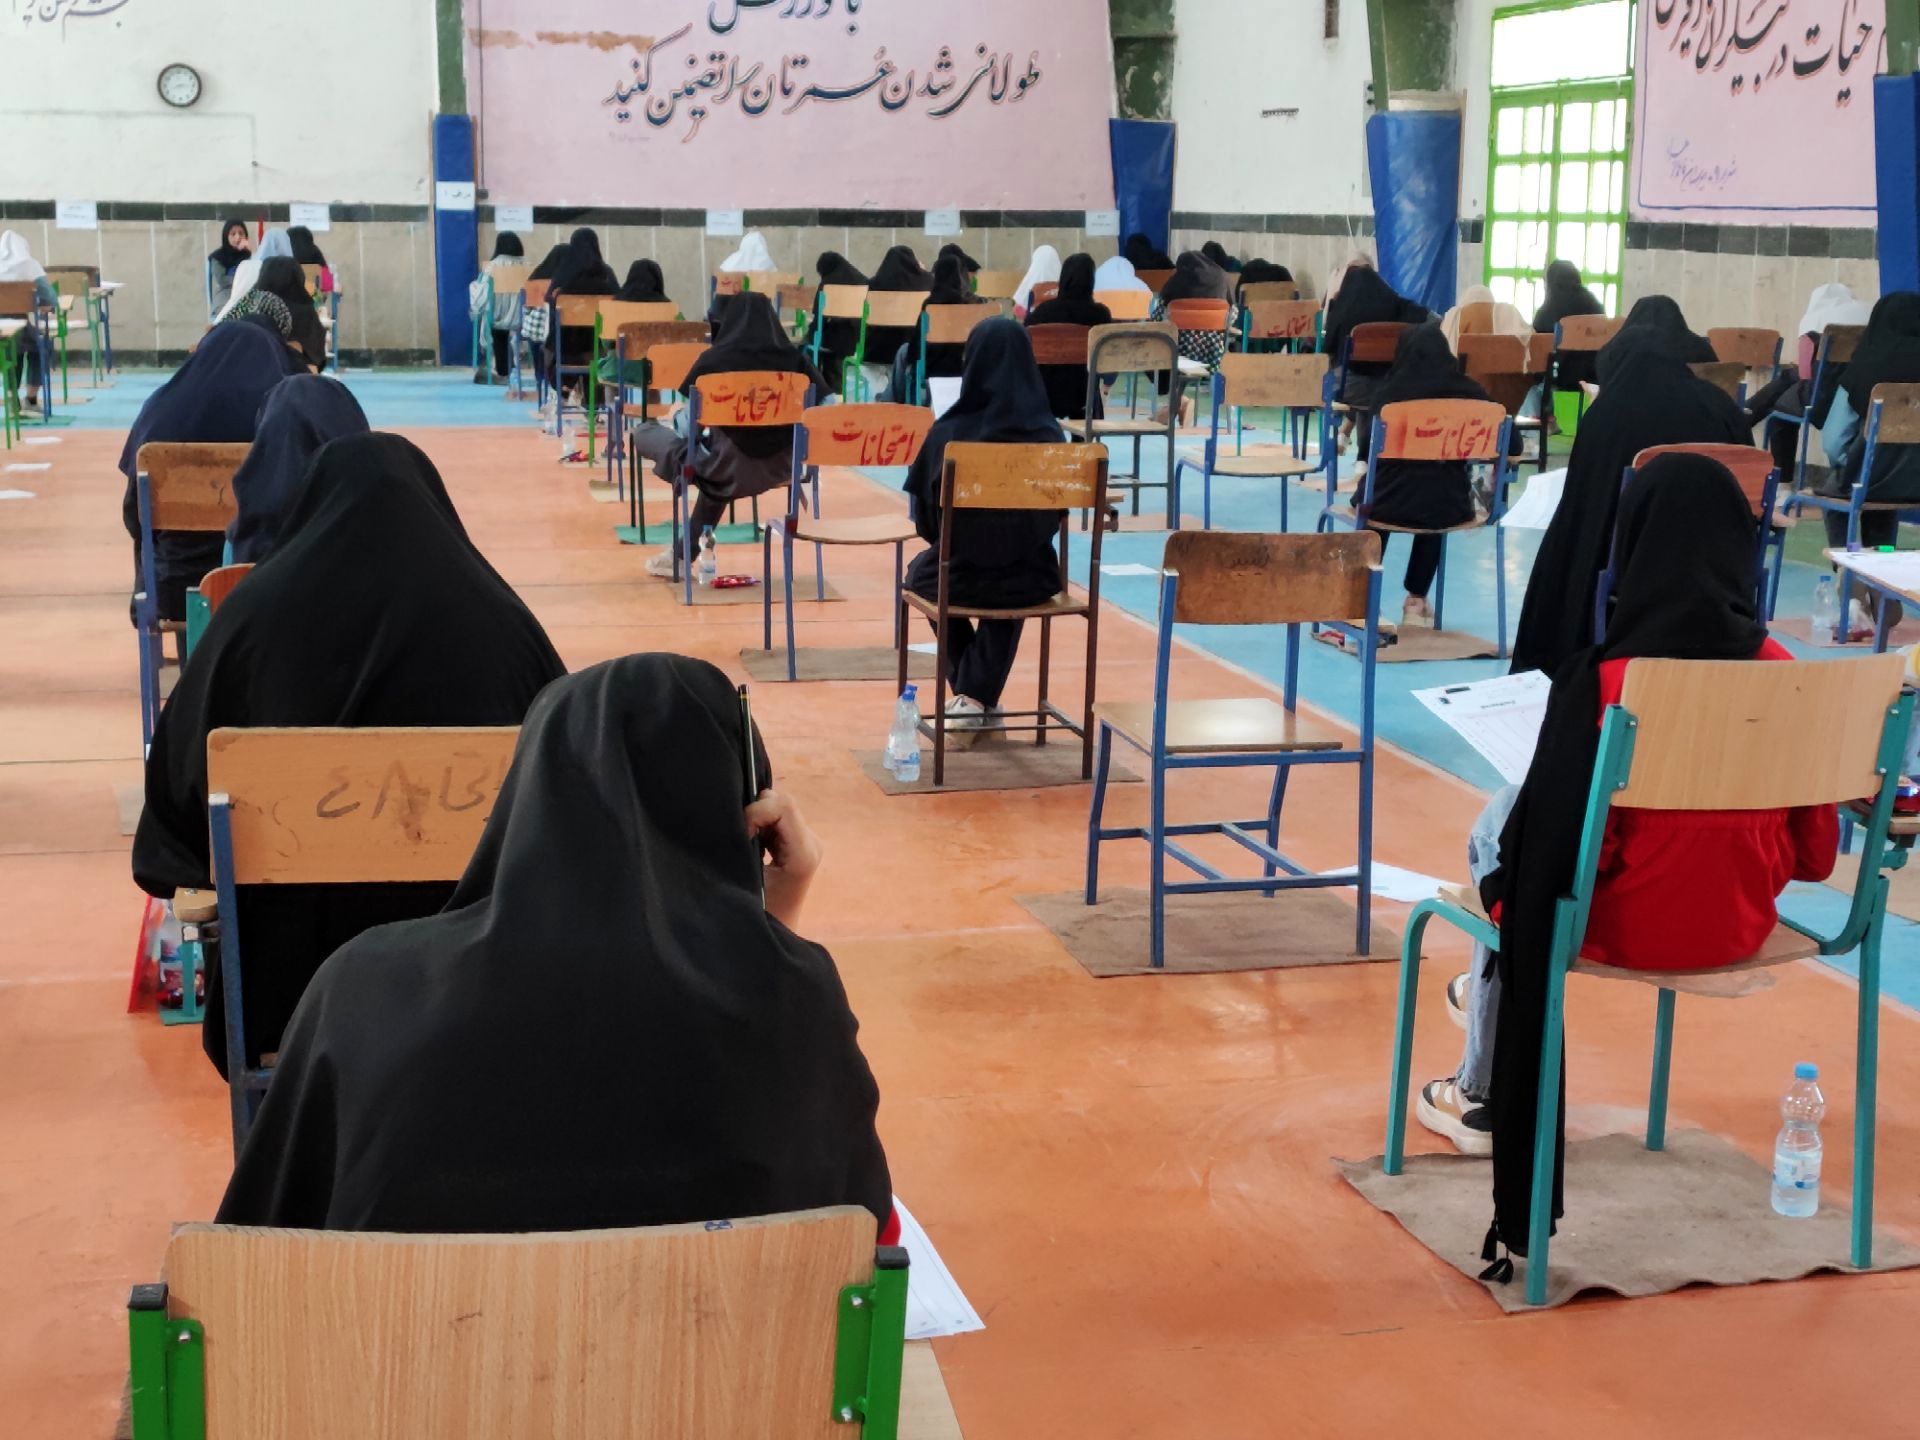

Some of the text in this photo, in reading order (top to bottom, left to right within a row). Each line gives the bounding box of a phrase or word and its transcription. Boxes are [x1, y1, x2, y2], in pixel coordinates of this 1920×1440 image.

[601, 22, 694, 121] کنید
[879, 45, 956, 112] شدن
[926, 42, 1042, 118] طولانی
[832, 420, 916, 466] امتحانات
[1415, 418, 1493, 460] امتحانات
